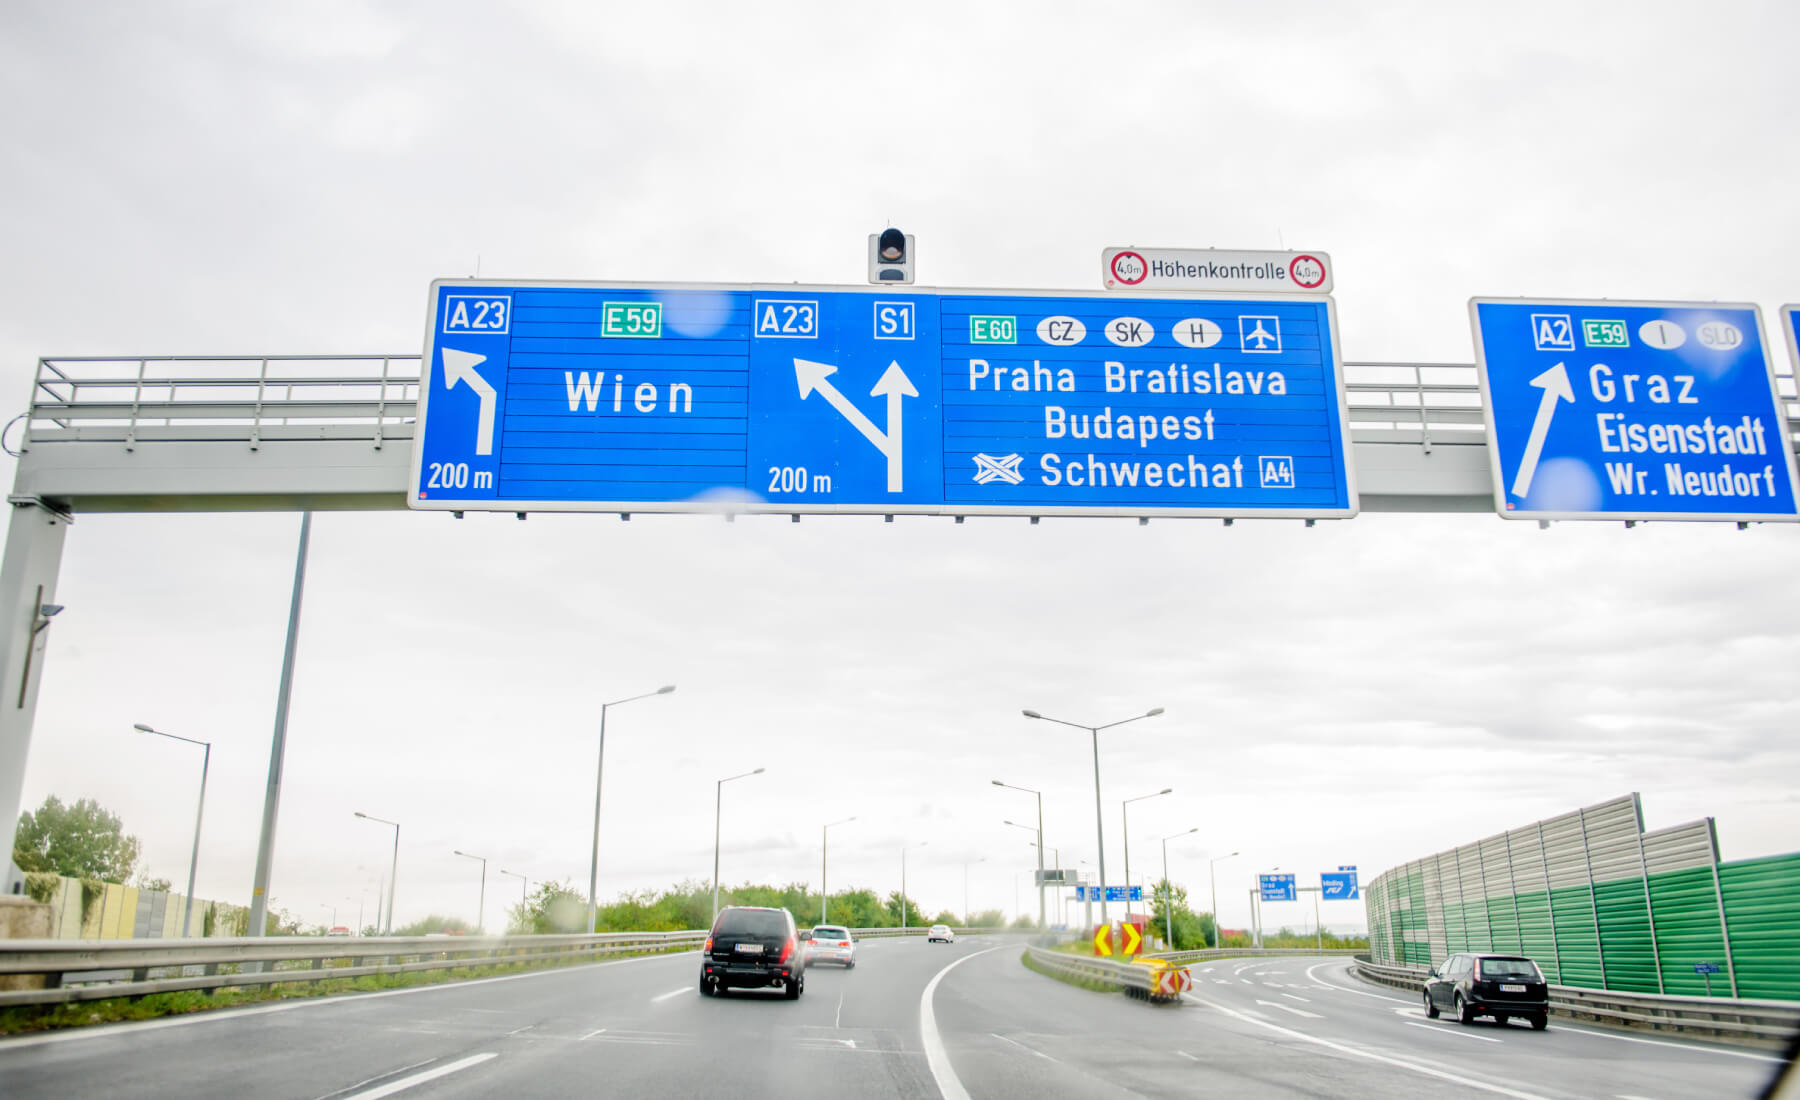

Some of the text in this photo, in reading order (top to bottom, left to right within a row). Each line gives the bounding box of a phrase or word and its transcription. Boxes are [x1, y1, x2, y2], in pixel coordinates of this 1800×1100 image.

[1151, 260, 1285, 280] Höhenkontrolle
[449, 301, 506, 329] A23
[606, 307, 657, 333] E59
[760, 305, 813, 333] A23
[880, 307, 909, 334] S1
[974, 319, 1204, 344] E60 CZ SK H
[1539, 320, 1570, 346] A2
[1586, 323, 1626, 344] E59
[1701, 326, 1737, 346] SLO
[969, 359, 1287, 396] Praha Bratislava
[1589, 363, 1699, 404] Graz
[564, 371, 693, 413] Wien
[1044, 405, 1215, 448] Budapest
[1596, 412, 1767, 455] Eisenstadt
[427, 462, 493, 489] 200 m
[768, 466, 832, 493] 200 m
[1040, 452, 1291, 488] Schwechat A4
[1605, 462, 1776, 497] Wr. Neudorf
